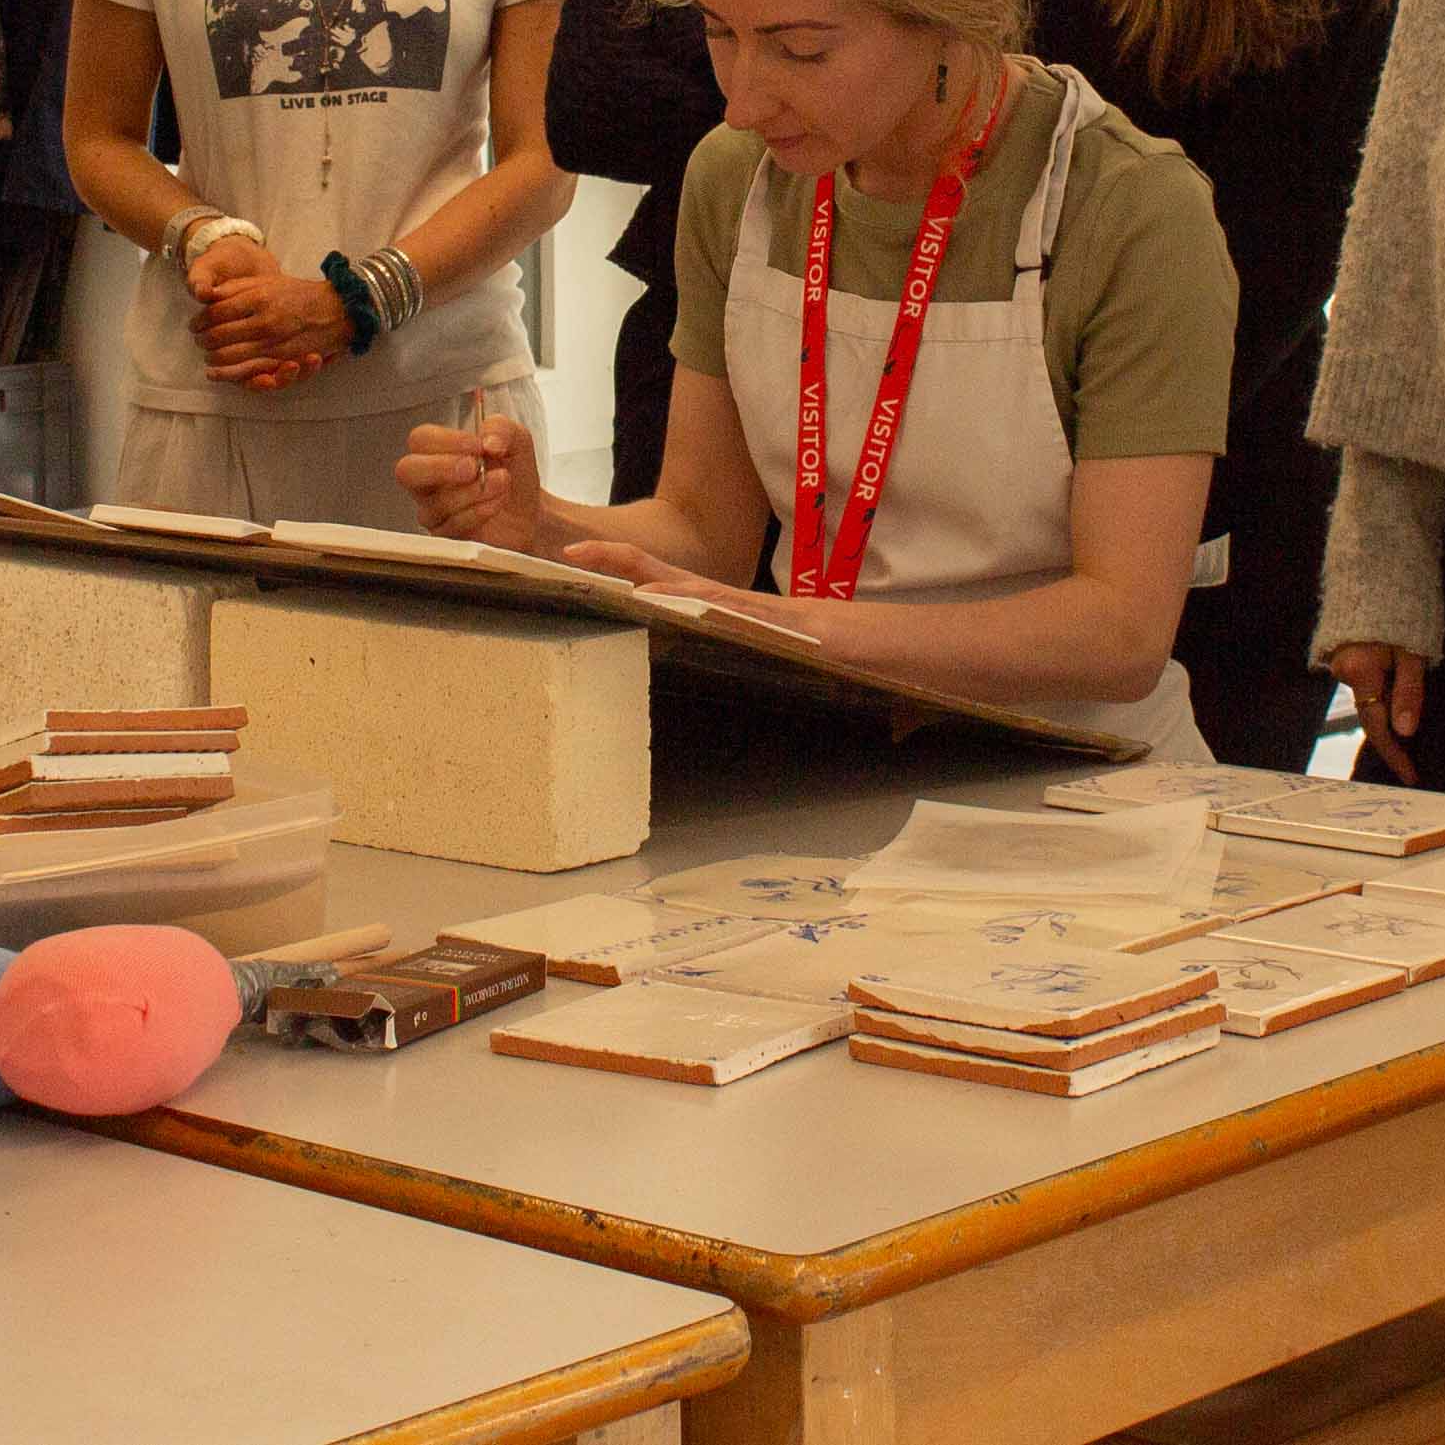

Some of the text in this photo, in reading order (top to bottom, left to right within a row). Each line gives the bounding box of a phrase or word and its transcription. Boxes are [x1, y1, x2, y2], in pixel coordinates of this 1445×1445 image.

[280, 91, 388, 109] LIVE ON STAGE
[806, 199, 829, 303] VISITOR
[903, 215, 950, 319] VISITOR
[800, 382, 820, 488] VISITOR
[854, 398, 900, 501] VISITOR
[463, 971, 530, 1006] NATURAL CHARCOAL
